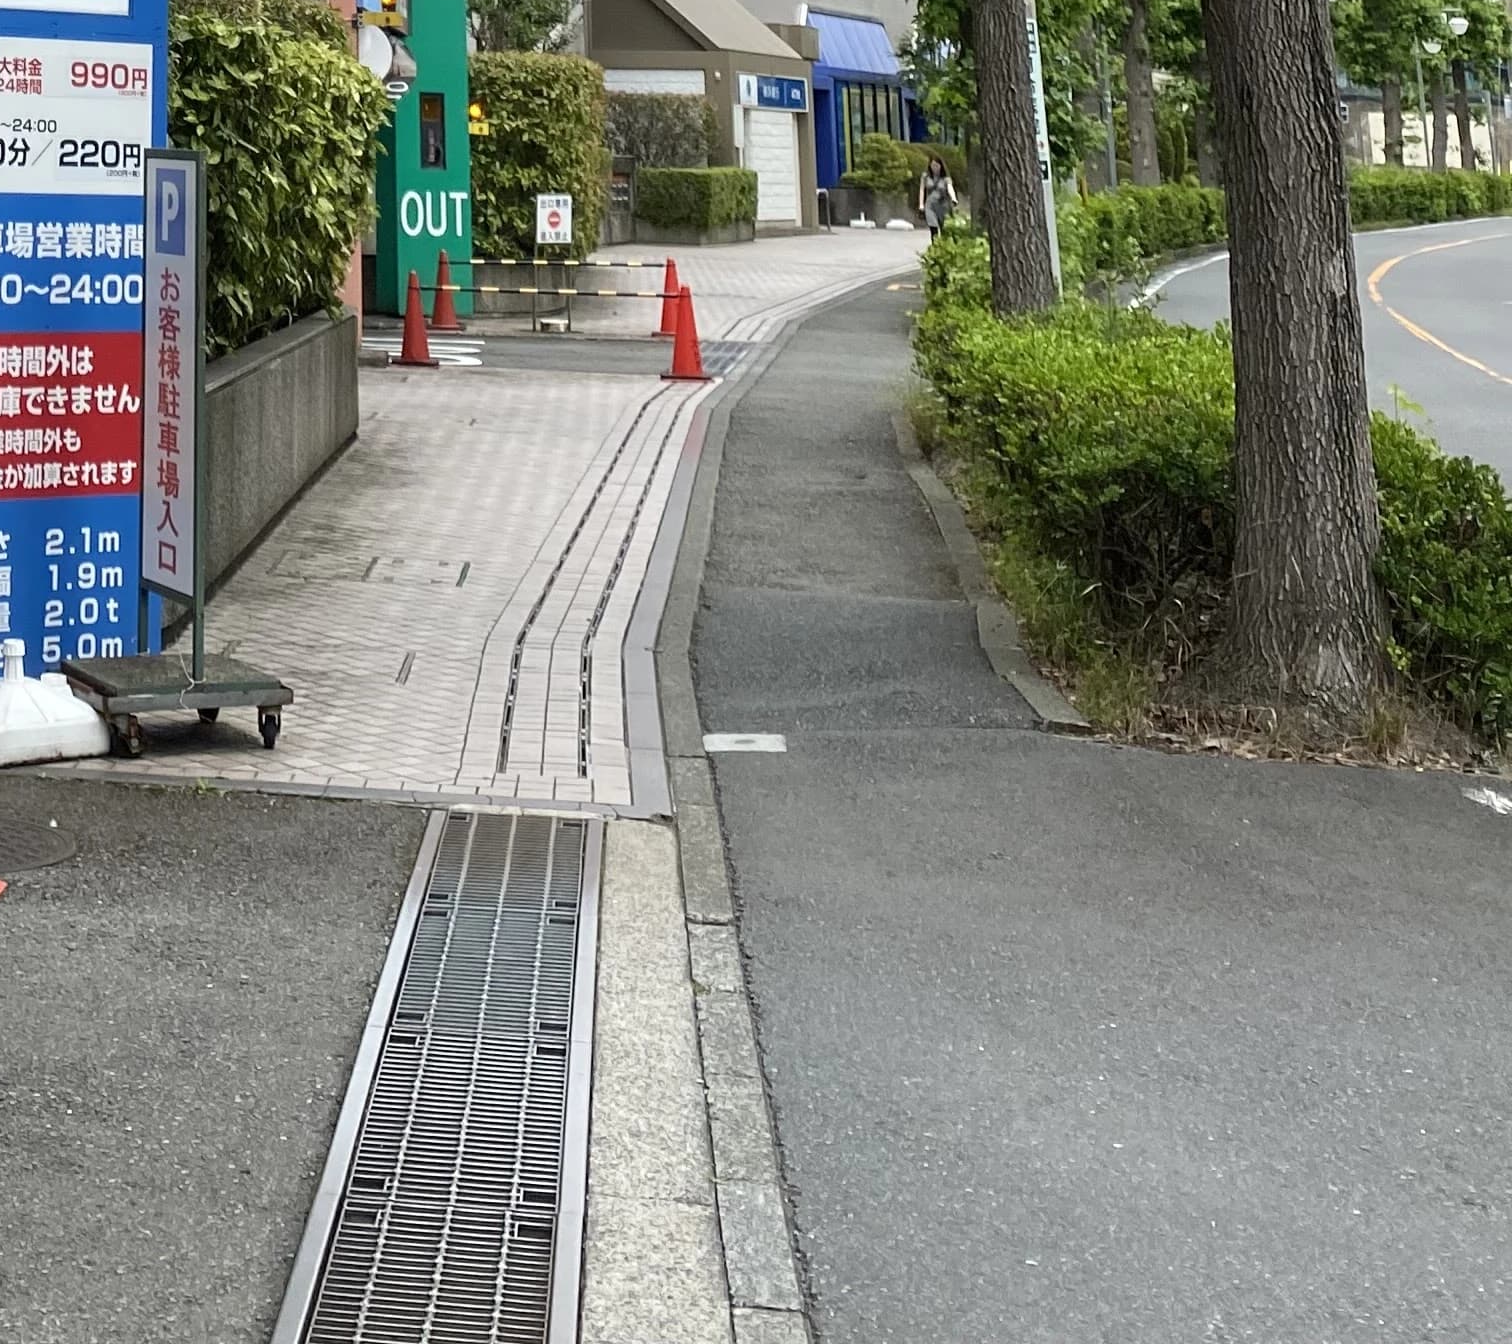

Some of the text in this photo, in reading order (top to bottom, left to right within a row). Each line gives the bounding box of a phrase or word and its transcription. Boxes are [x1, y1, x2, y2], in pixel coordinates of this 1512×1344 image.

[71, 61, 148, 90] 990円
[161, 180, 180, 242] P
[400, 190, 468, 238] OUT
[156, 266, 181, 576] お客様駐車場入口
[44, 527, 120, 558] 2.1m
[47, 563, 123, 591] 1.9m
[43, 597, 119, 628] 2.0t
[42, 632, 123, 666] 5.0m
